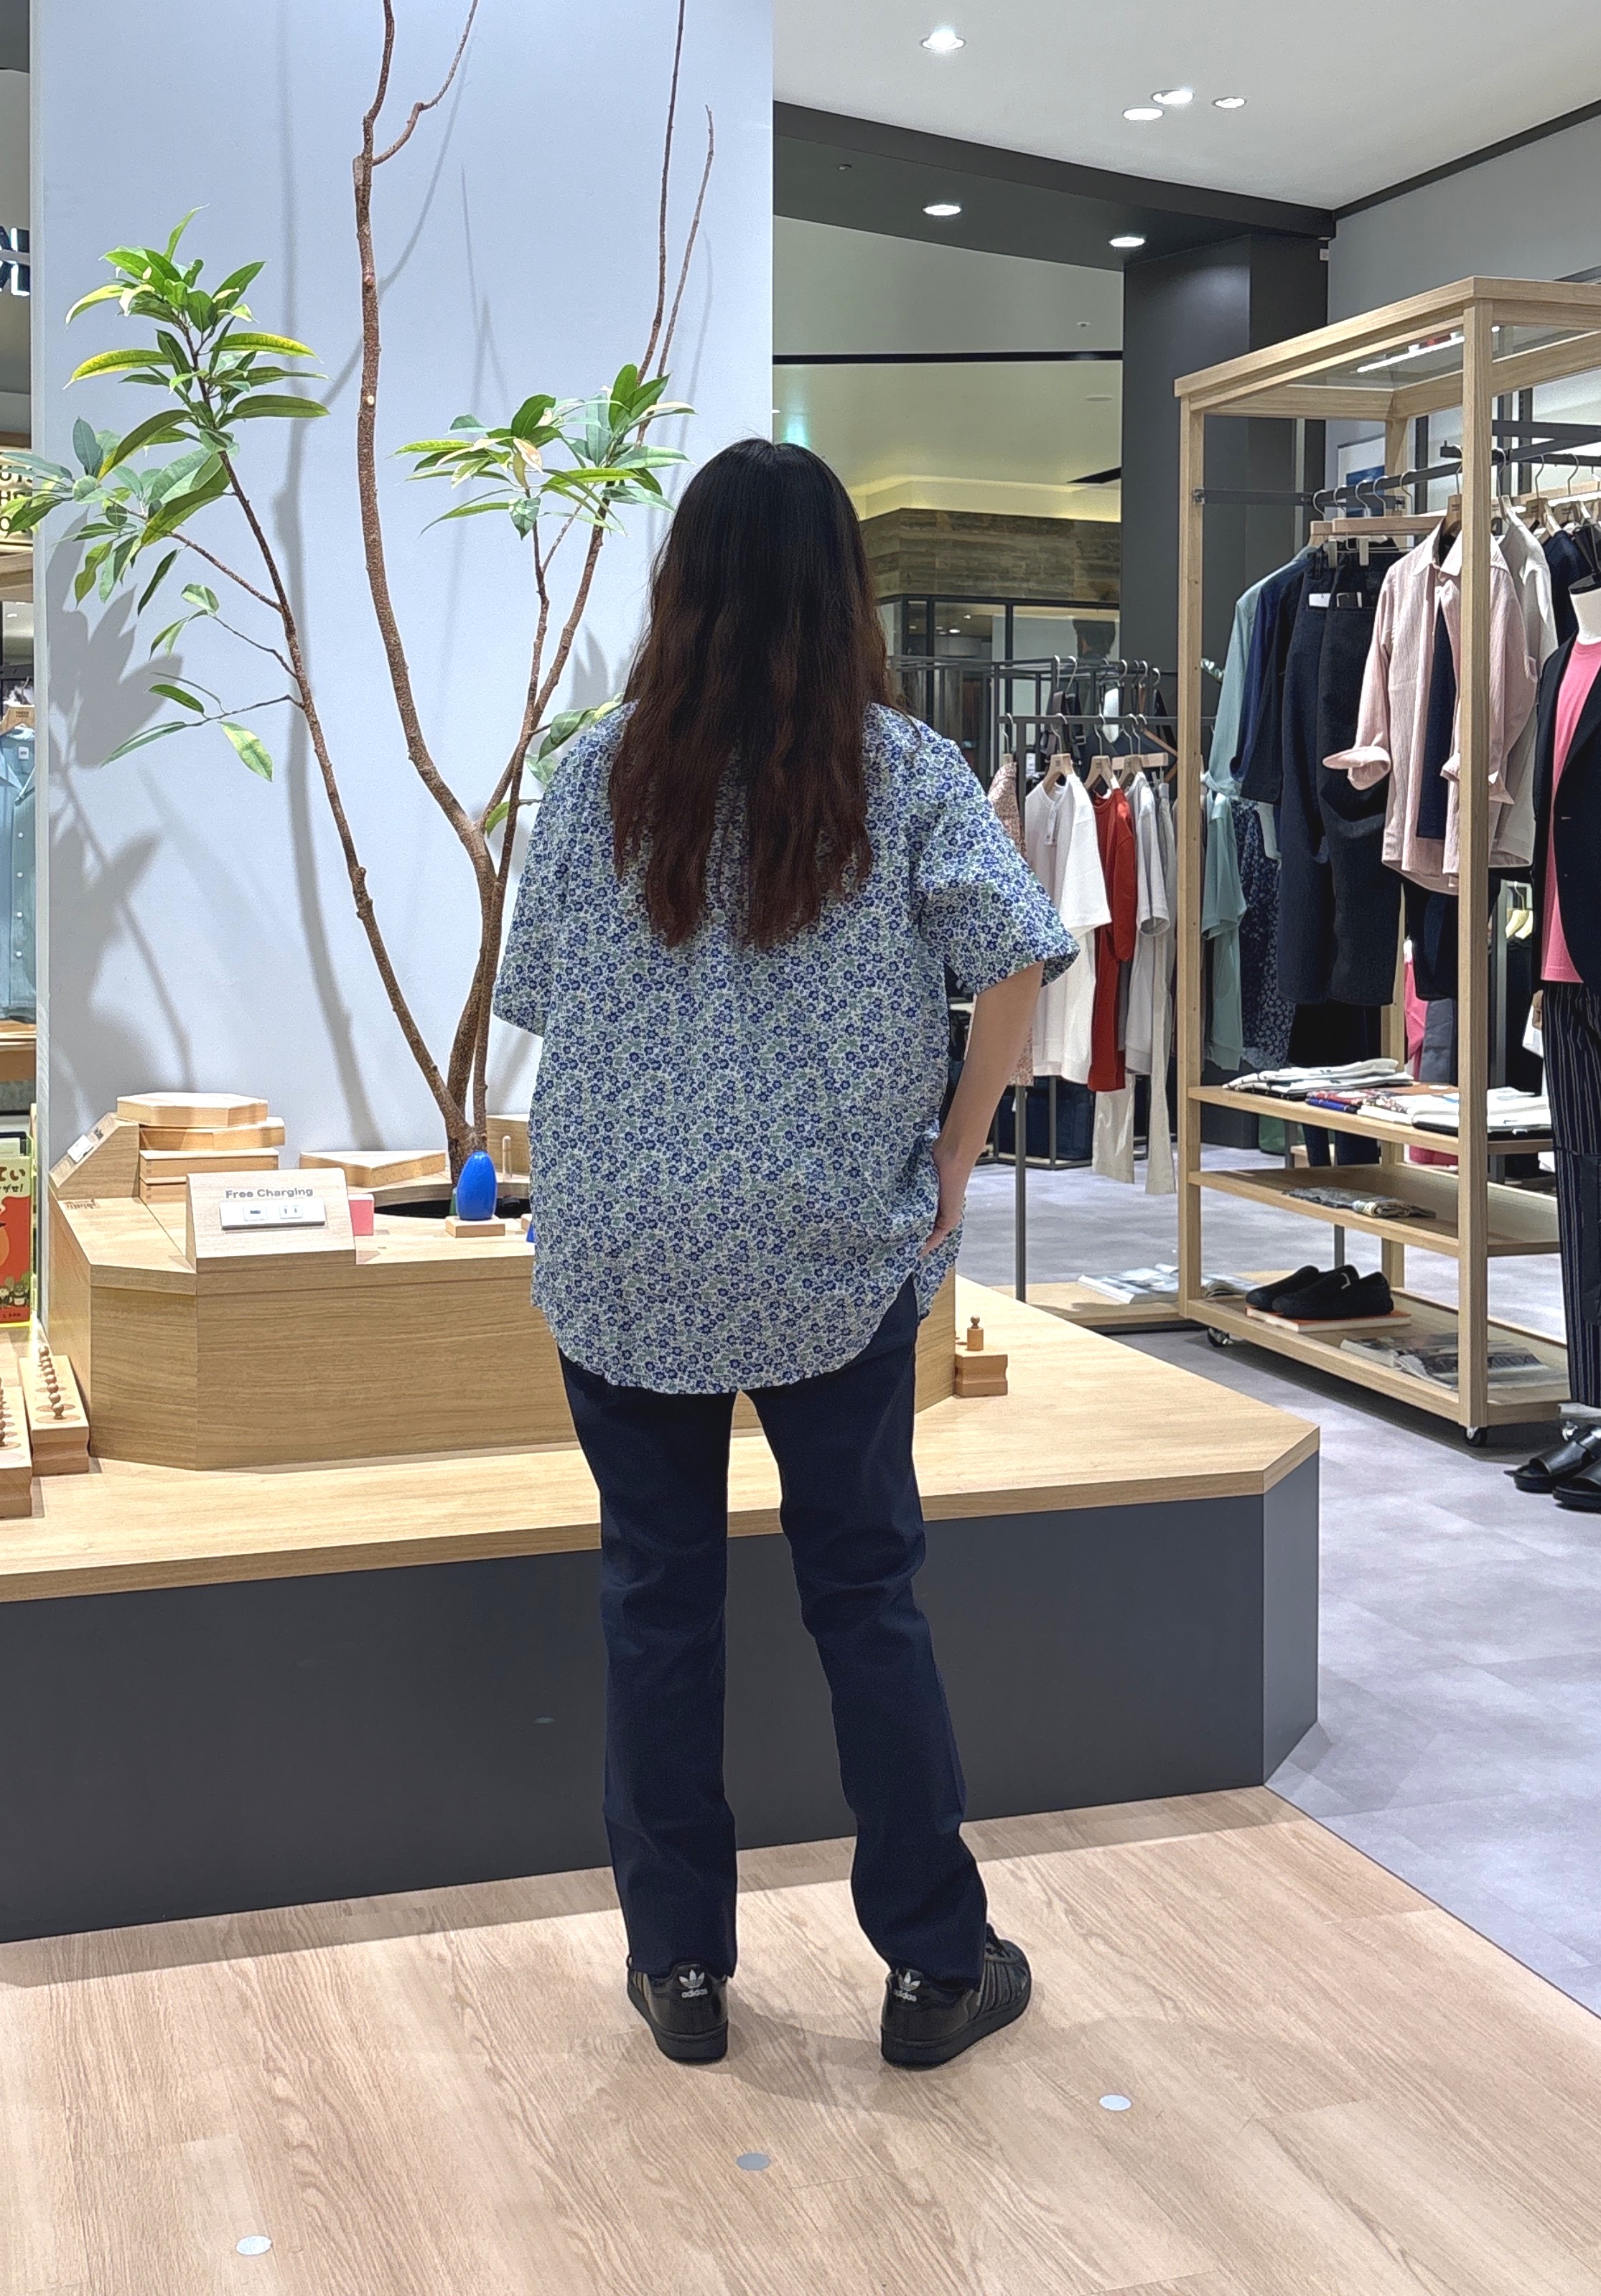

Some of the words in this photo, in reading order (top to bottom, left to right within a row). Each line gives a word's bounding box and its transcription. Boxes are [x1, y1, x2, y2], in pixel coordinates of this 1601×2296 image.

[225, 1190, 253, 1199] Free
[257, 1188, 314, 1198] Charging
[681, 1988, 709, 1999] adidas
